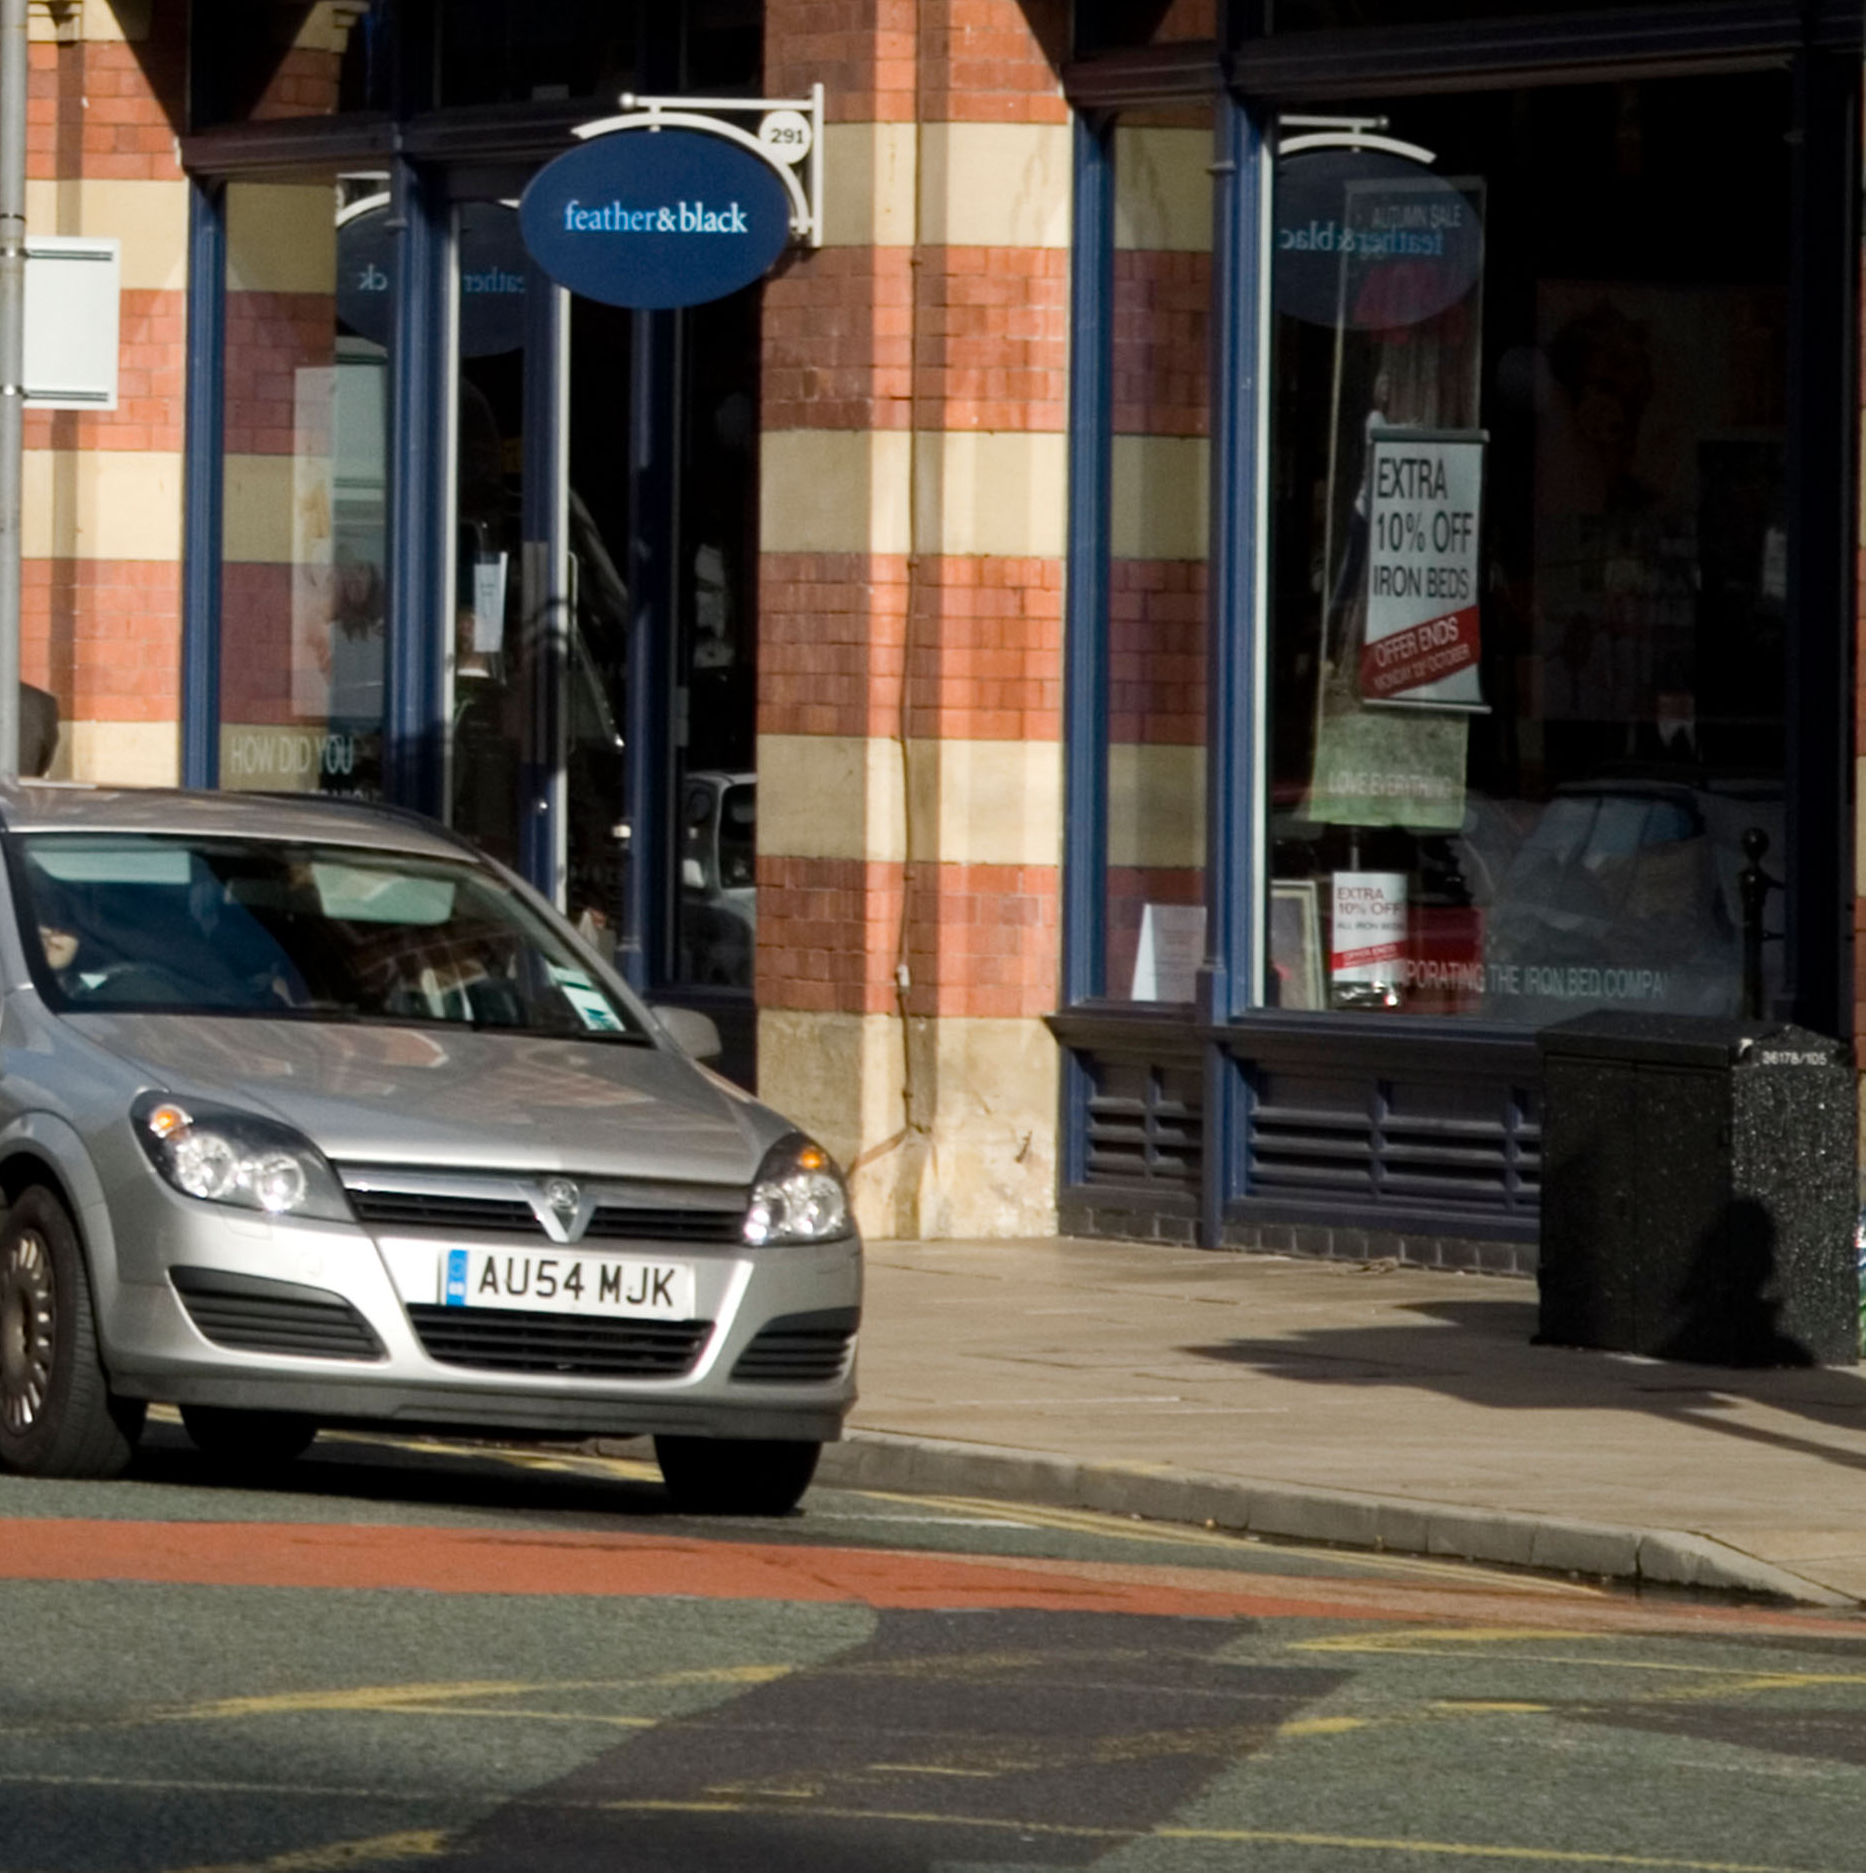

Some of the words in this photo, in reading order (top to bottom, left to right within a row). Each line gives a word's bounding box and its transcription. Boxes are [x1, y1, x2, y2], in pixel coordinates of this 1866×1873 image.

[770, 128, 805, 145] 291
[564, 198, 750, 234] feather&black
[1377, 457, 1448, 500] EXTRA
[1377, 512, 1426, 552] 10%
[1432, 511, 1473, 553] OFF
[1373, 566, 1422, 598] IRON
[1426, 568, 1470, 600] BEDS
[1374, 632, 1419, 668] OFFER
[1418, 616, 1459, 652] ENDS
[231, 735, 274, 775] HOW
[280, 735, 312, 774] DID
[316, 733, 354, 776] YOU
[1336, 887, 1385, 901] EXTRA
[1337, 901, 1367, 915] 10%
[1371, 901, 1401, 915] OFF
[1407, 961, 1485, 995] PORATING
[1488, 964, 1519, 995] THE
[1524, 965, 1564, 996] IRON
[1570, 967, 1602, 997] BED
[1604, 969, 1668, 999] COMPA
[478, 1255, 585, 1301] AU54
[598, 1263, 675, 1307] MJK
